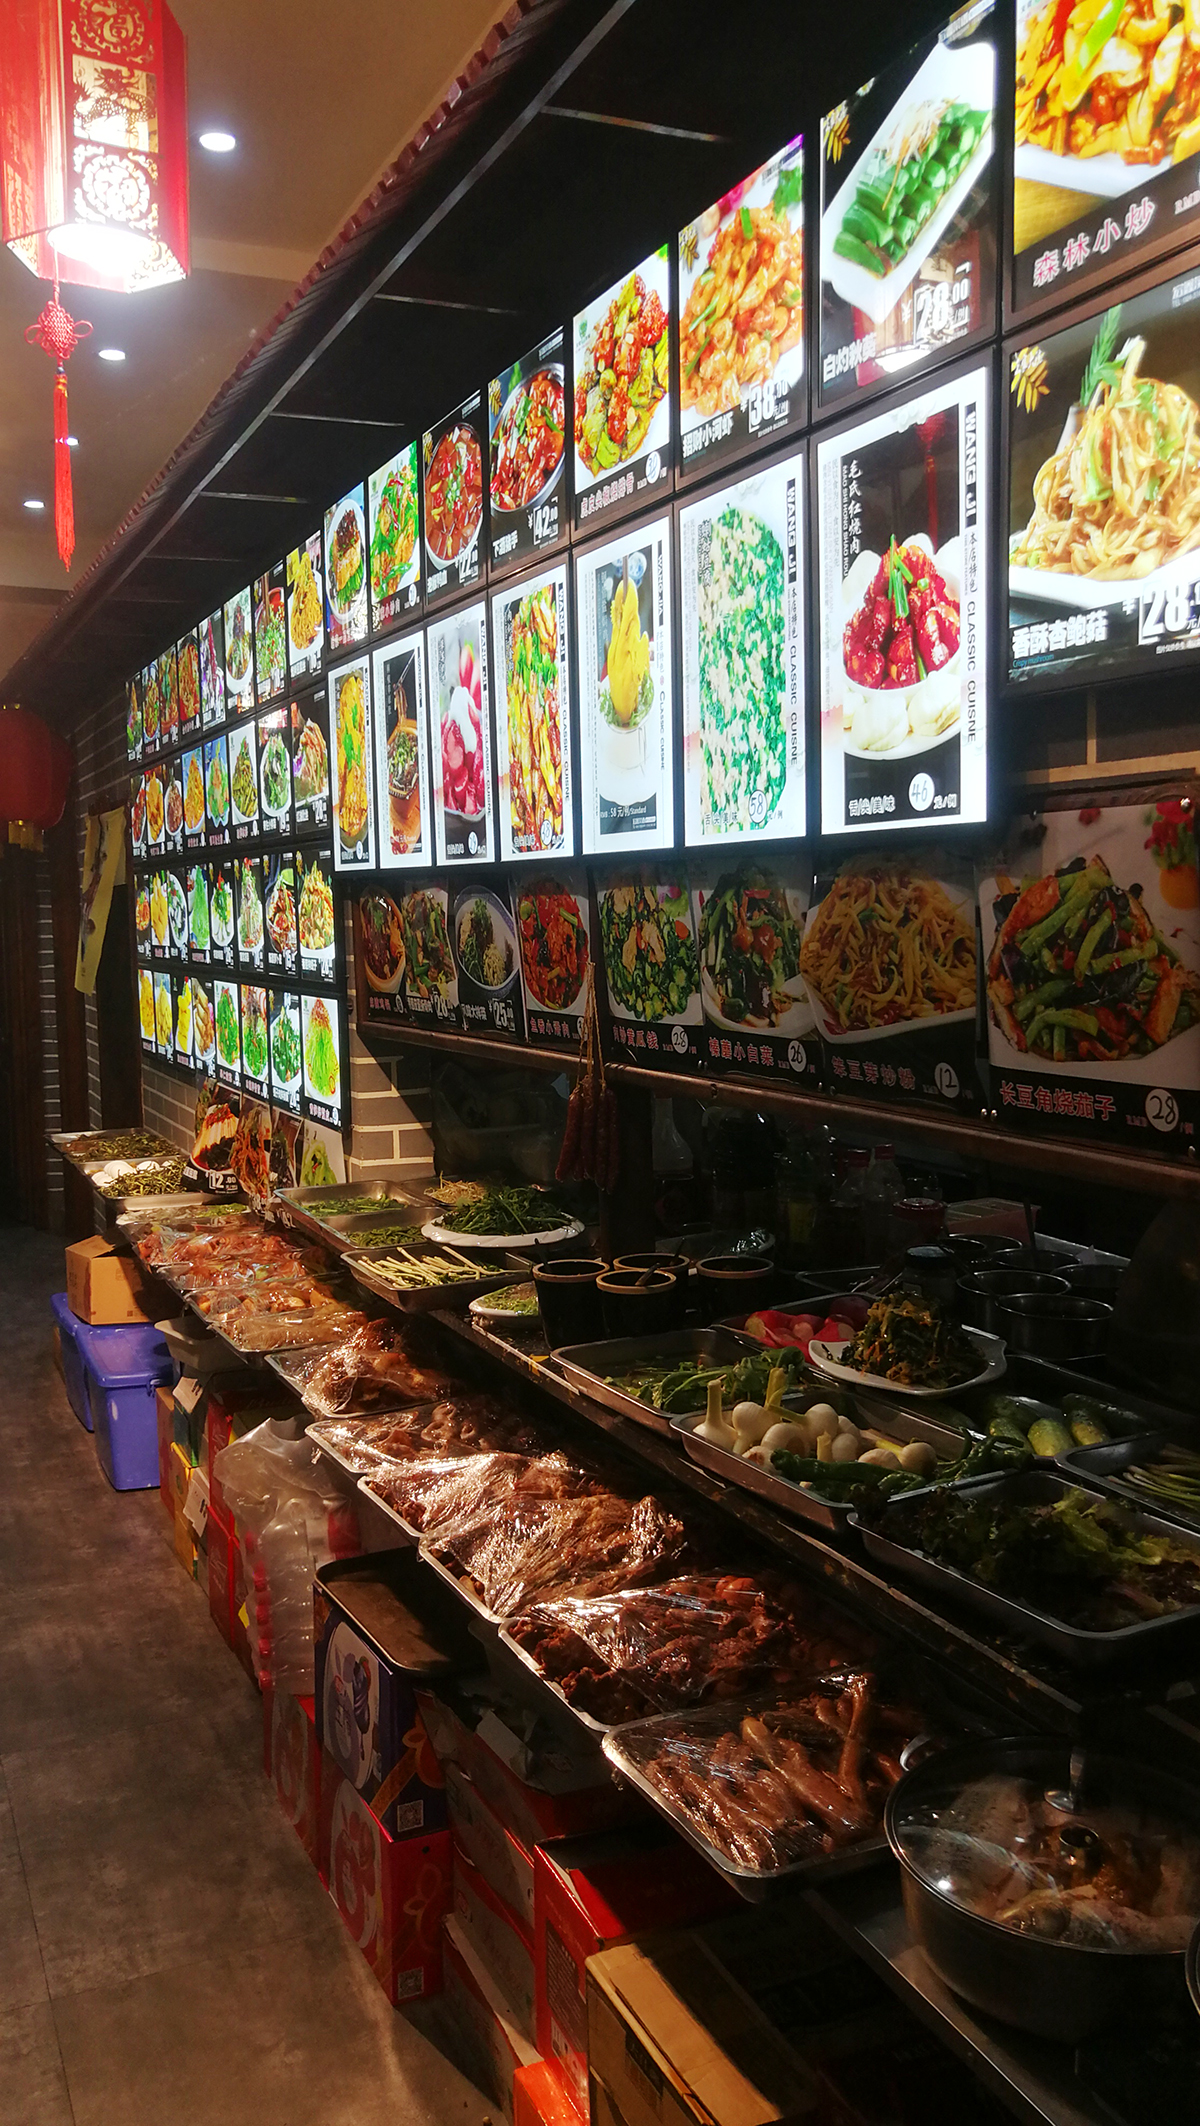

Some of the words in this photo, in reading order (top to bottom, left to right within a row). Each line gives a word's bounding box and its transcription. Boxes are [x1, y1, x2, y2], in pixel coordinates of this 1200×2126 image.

[1033, 197, 1155, 287] 森林小炒
[823, 333, 876, 383] 白灼秋葵
[683, 411, 733, 458] 招财小河虾
[965, 411, 976, 484] WANG
[787, 487, 795, 547] WANG
[849, 460, 862, 554] 毛氏红烧肉
[966, 491, 976, 518] JI
[788, 554, 796, 575] JI
[968, 532, 977, 593] 本店特色
[967, 600, 976, 671] CLASSIC
[1012, 610, 1108, 659] 香酥杏鲍菇
[1013, 658, 1027, 668] Crispy
[1029, 653, 1055, 665] mushroom
[967, 680, 976, 742] CUISNE
[705, 812, 738, 826] 舌尖美味
[750, 793, 764, 817] 58
[613, 1025, 659, 1050] 肉炒黄瓜钱
[673, 1032, 686, 1048] 28
[708, 1037, 774, 1067] 榛蘑小白菜
[790, 1045, 803, 1064] 26
[831, 1055, 916, 1090] 笨豆芽炒粉
[939, 1067, 957, 1092] 12
[1000, 1080, 1116, 1121] 长豆角烧茄子
[1150, 1094, 1176, 1124] 28
